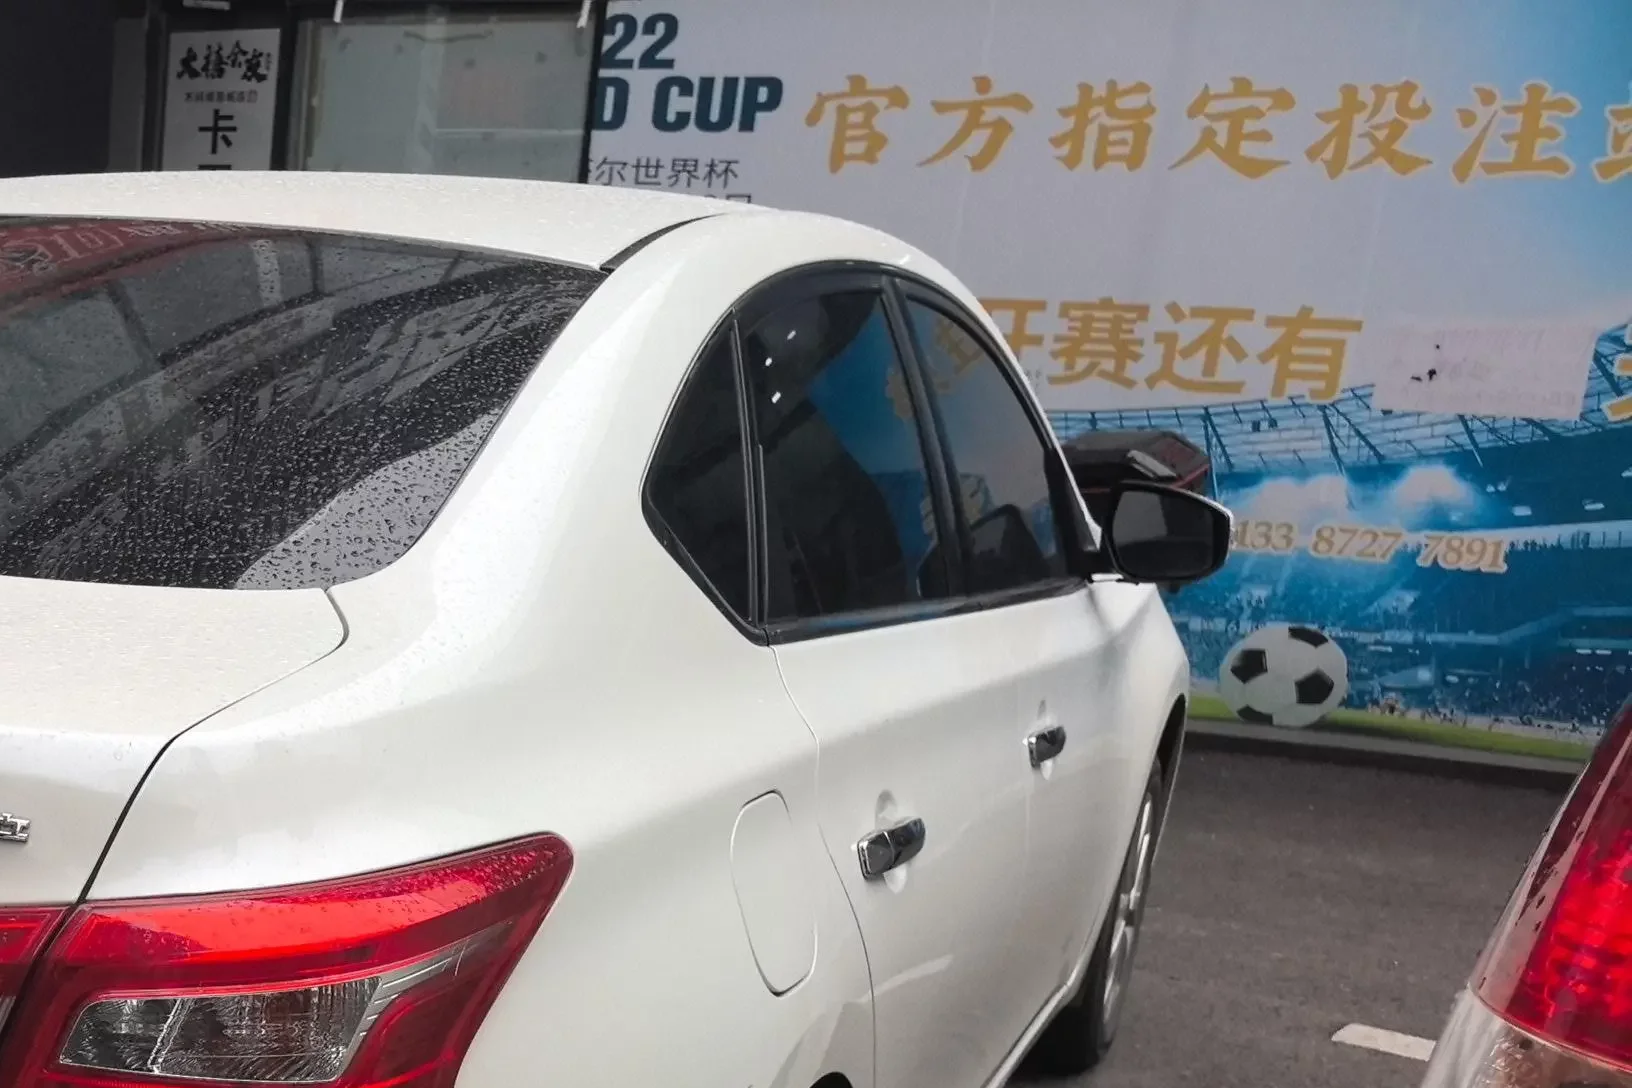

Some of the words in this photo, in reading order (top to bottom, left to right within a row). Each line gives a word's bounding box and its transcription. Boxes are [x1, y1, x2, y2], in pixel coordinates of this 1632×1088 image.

[599, 13, 680, 70] 22
[651, 75, 783, 133] CUP
[588, 156, 740, 188] 尔世界杯
[976, 296, 1364, 399] 开赛还有
[1235, 519, 1295, 550] 133
[1311, 525, 1404, 560] 8727
[1421, 533, 1507, 572] 7891
